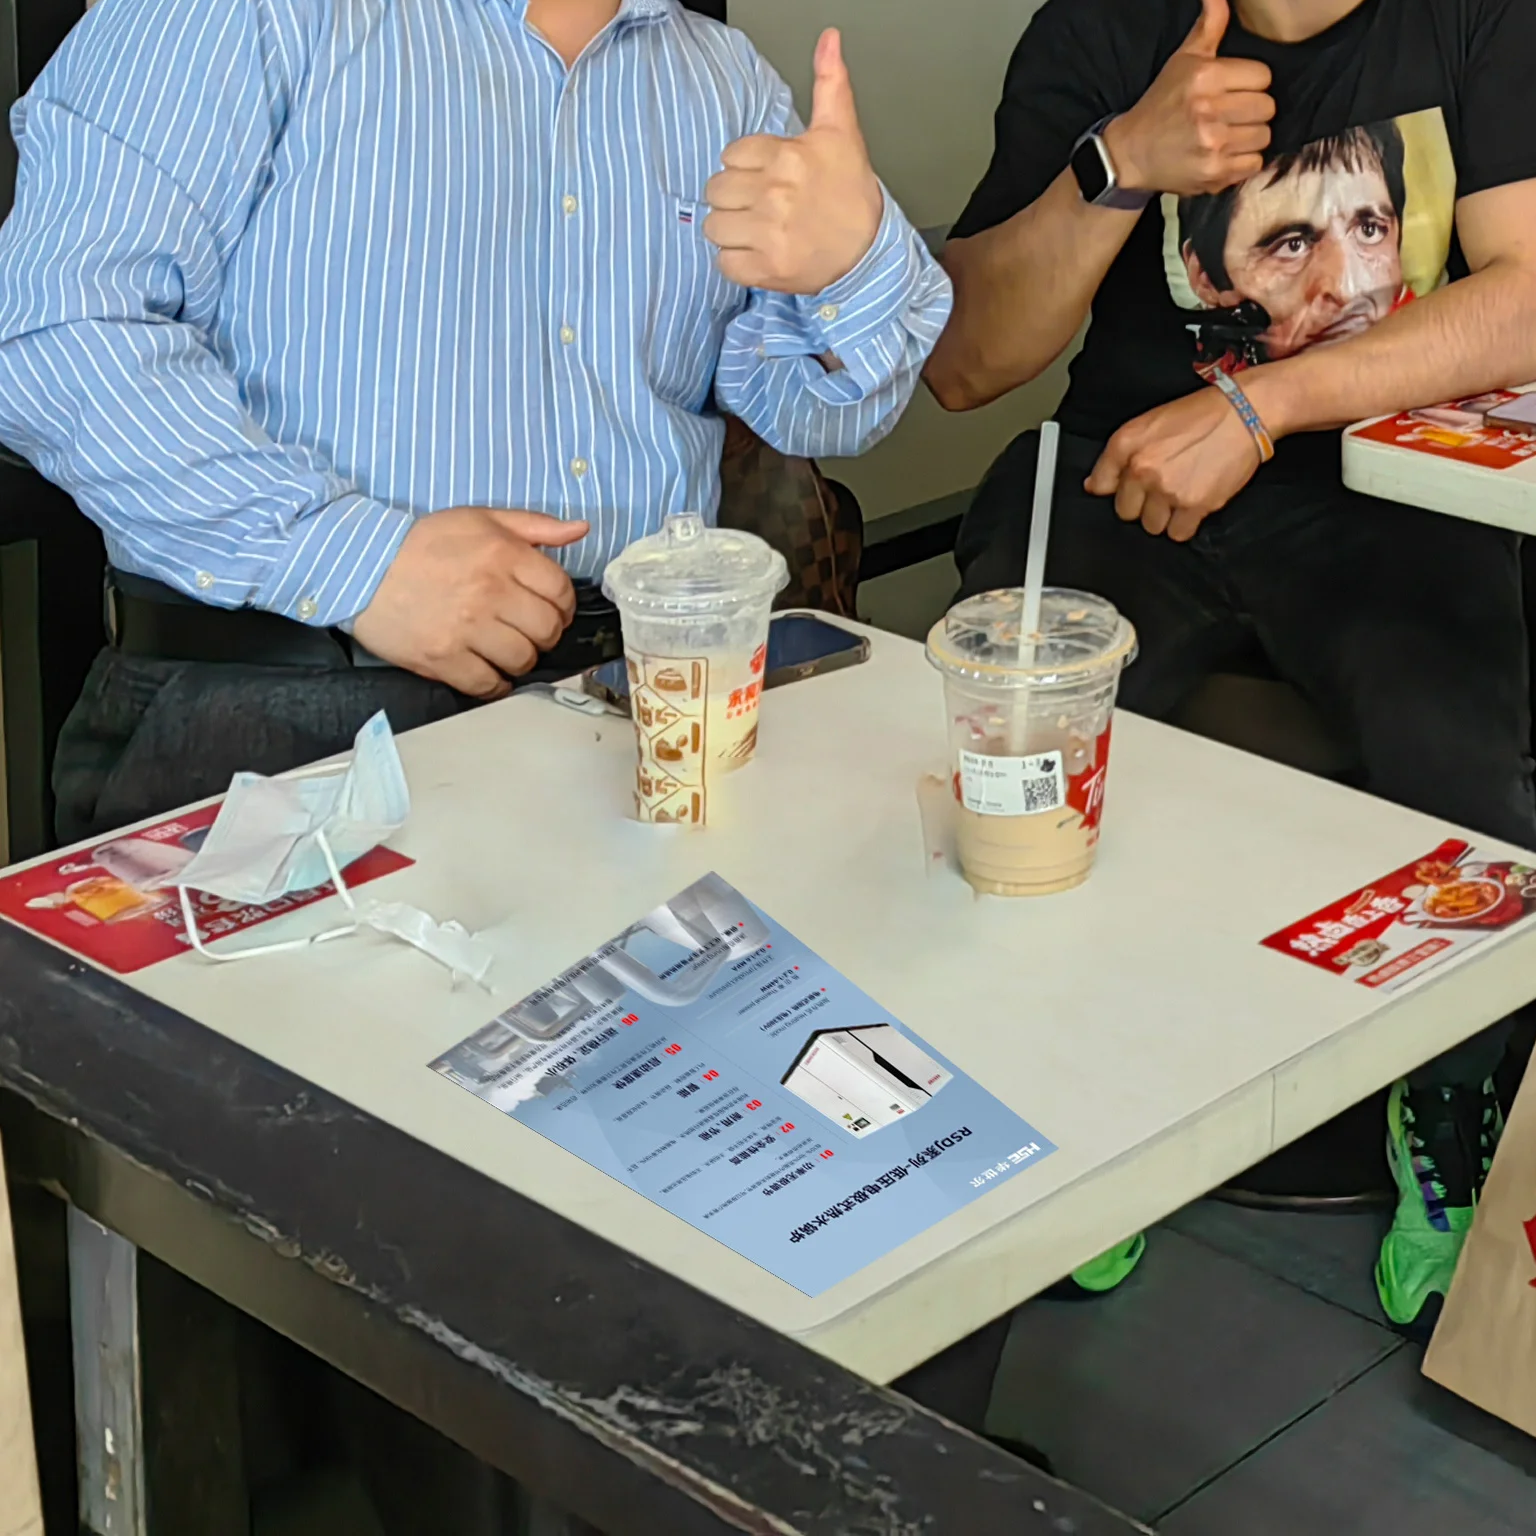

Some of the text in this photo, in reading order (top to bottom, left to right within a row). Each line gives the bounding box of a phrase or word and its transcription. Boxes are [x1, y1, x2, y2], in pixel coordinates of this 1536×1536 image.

[619, 1012, 640, 1026] 06
[662, 1042, 683, 1056] 05
[674, 1068, 721, 1099] 04 智能
[743, 1098, 764, 1111] 03
[777, 1121, 797, 1133] 02
[818, 1148, 835, 1160] 01
[967, 1142, 1041, 1188] HSE 华世尔
